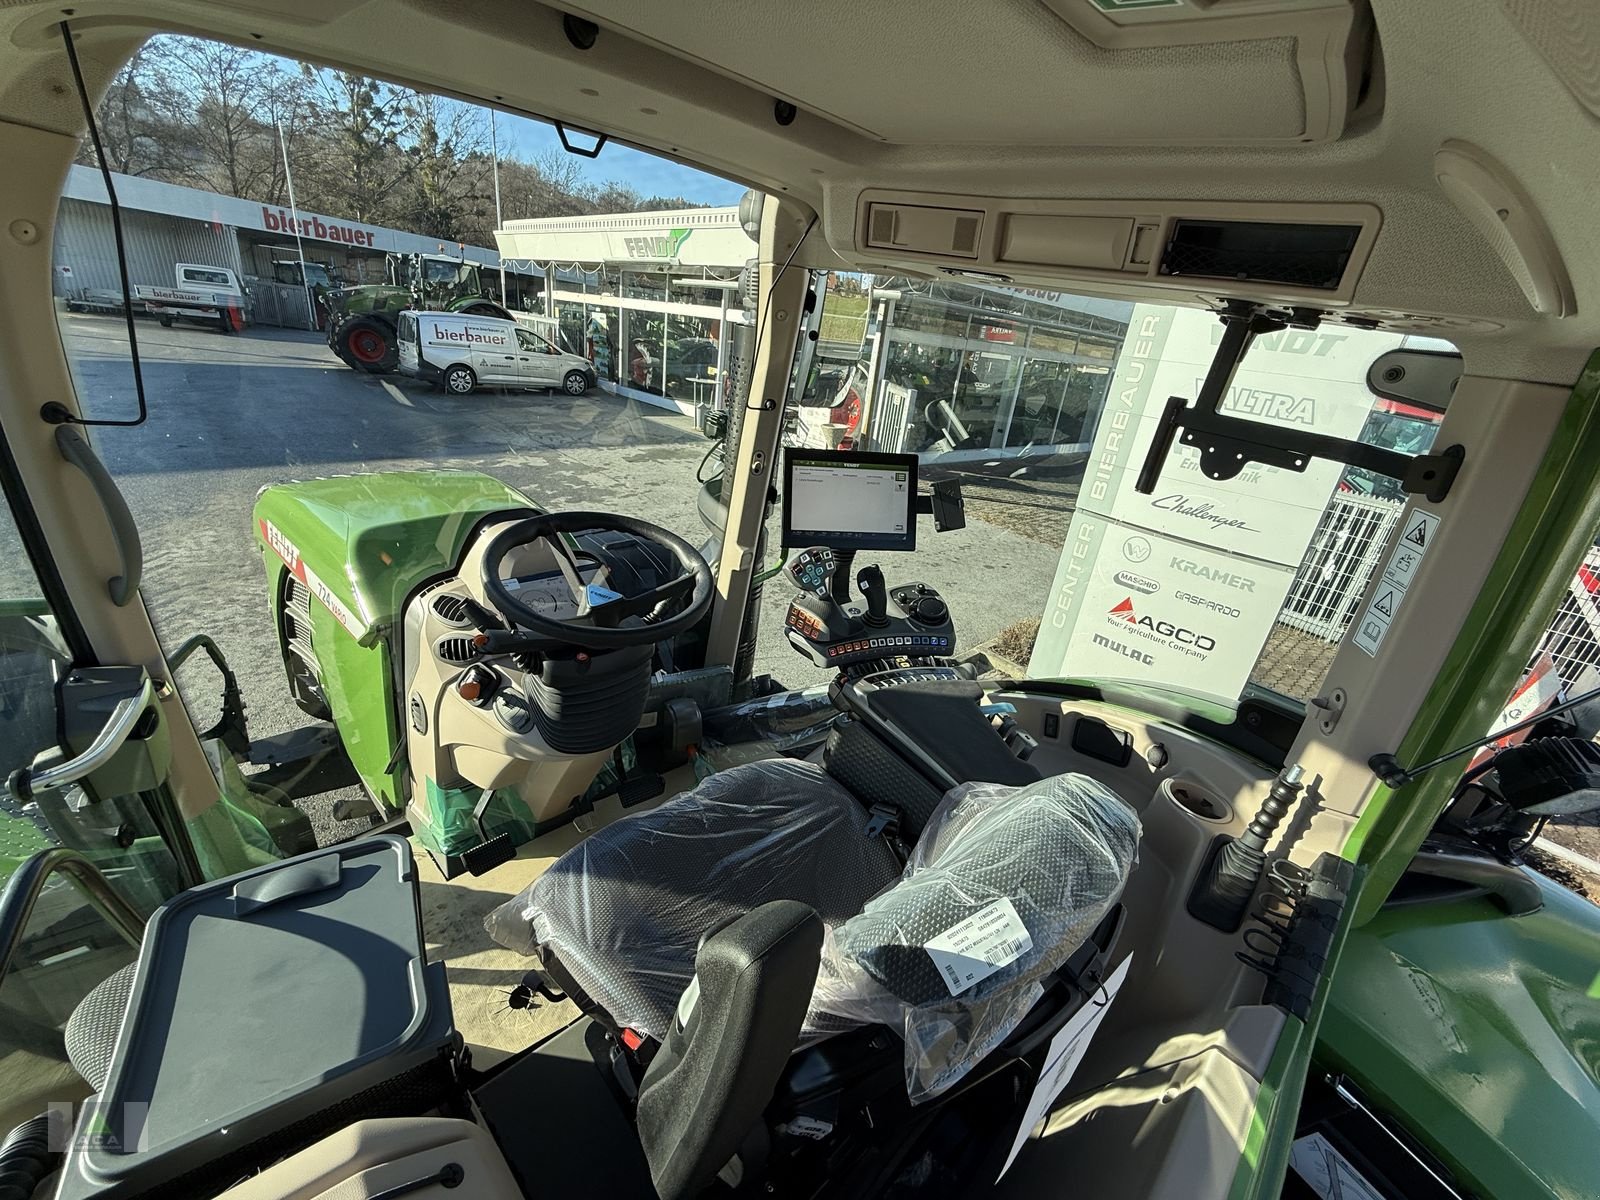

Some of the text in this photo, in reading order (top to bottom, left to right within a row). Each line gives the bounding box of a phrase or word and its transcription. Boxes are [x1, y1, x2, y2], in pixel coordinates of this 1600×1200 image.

[262, 206, 375, 247] bierbauer
[623, 236, 679, 258] FENDT
[152, 288, 201, 301] bierbauer
[433, 323, 507, 345] bierbauer
[1051, 313, 1161, 629] CENTER BIERBAUER
[1150, 494, 1262, 533] Challenger
[1119, 571, 1159, 591] MASCHIO
[1169, 556, 1257, 594] KRAMER
[1174, 590, 1241, 619] GASPARDO
[1107, 616, 1208, 662] Your Agriculture Company
[1137, 615, 1217, 652] AGCO
